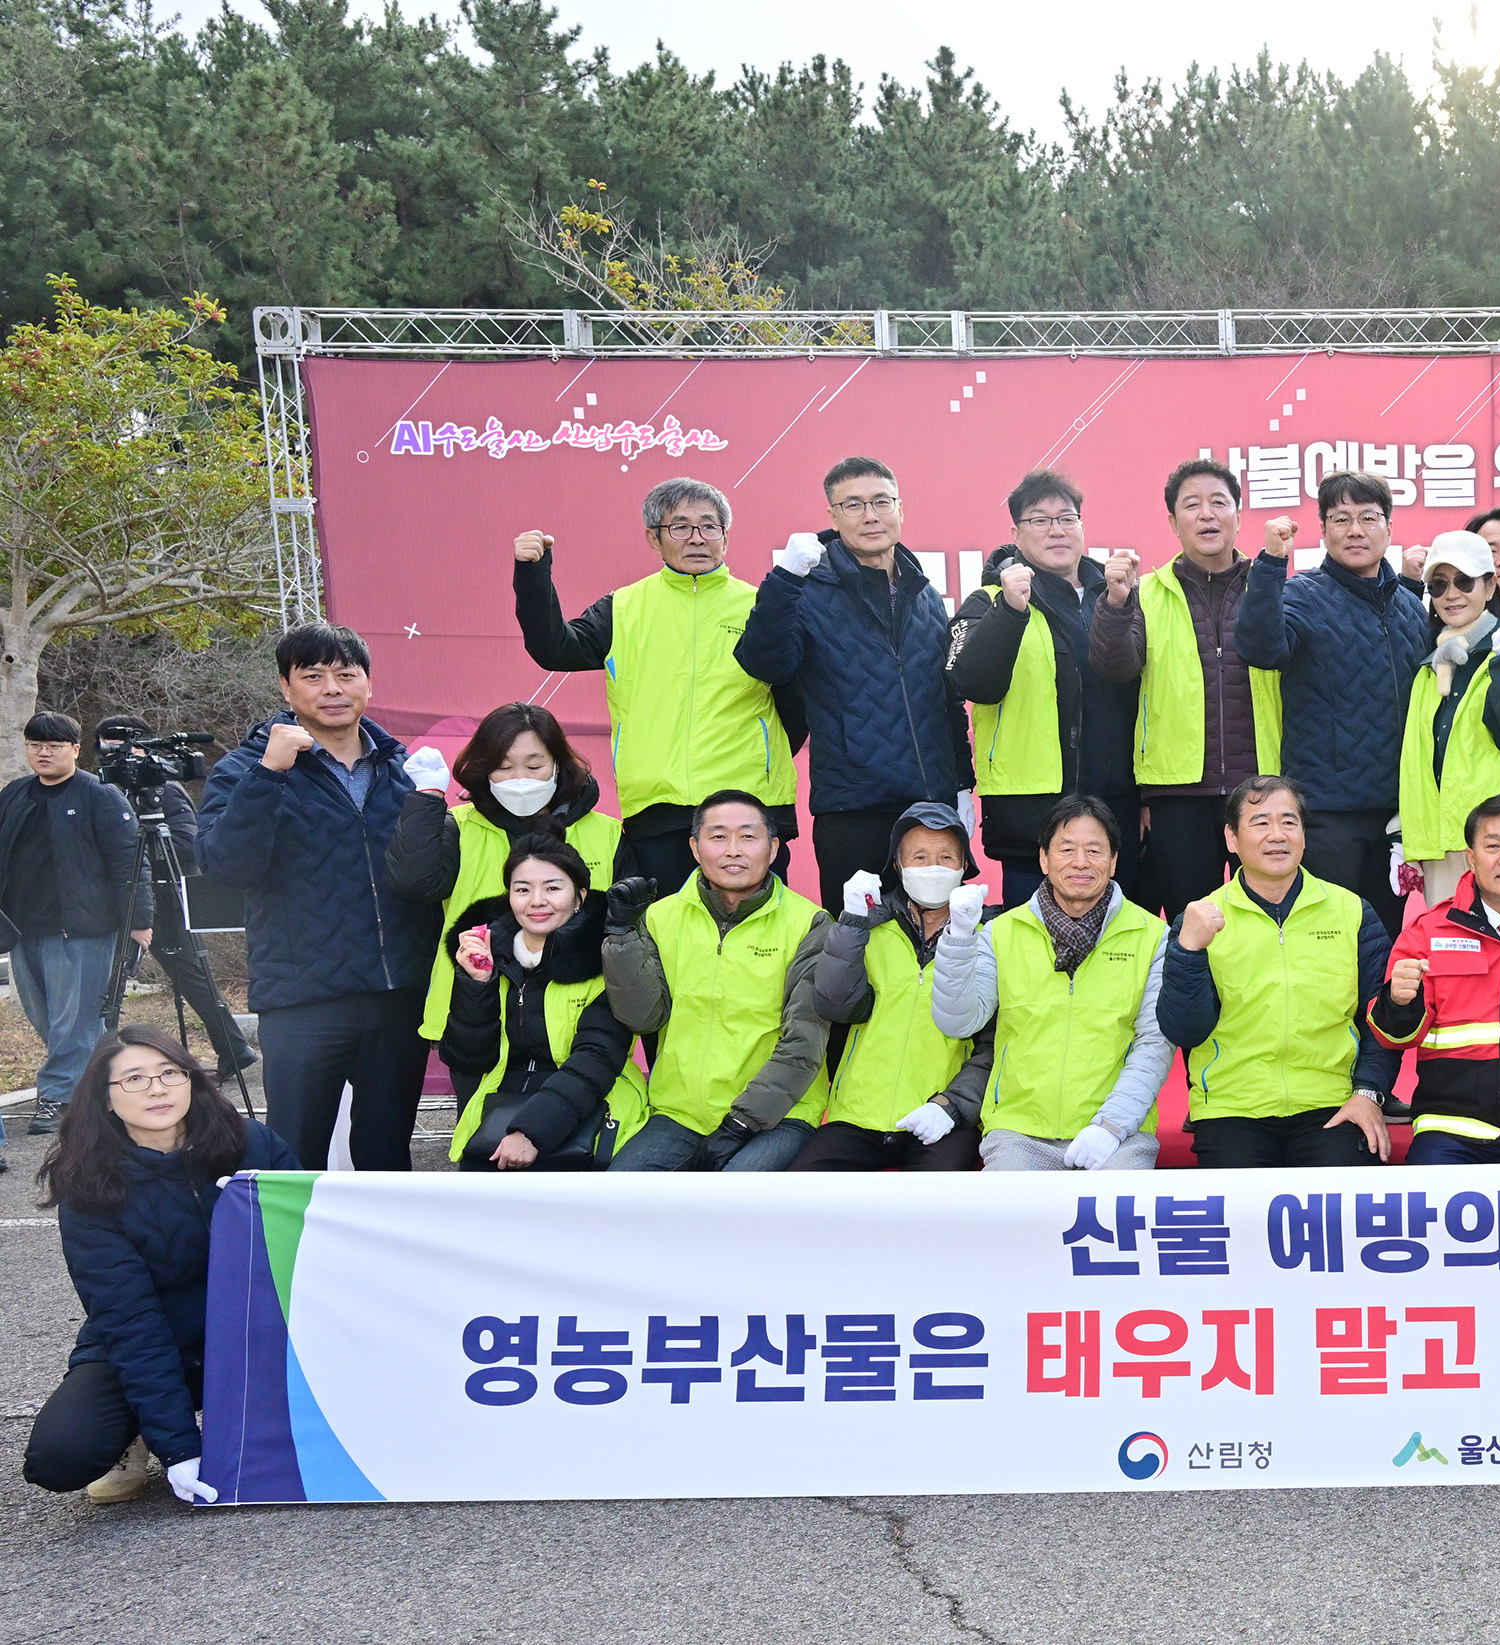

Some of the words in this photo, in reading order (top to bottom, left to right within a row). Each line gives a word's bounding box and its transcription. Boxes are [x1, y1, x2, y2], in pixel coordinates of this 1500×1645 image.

[1199, 440, 1476, 509] 불예방을
[1062, 1195, 1231, 1276] 산불
[462, 1312, 989, 1407] 영농부산물은
[1026, 1307, 1275, 1399] 태우지
[1315, 1306, 1481, 1396] 말고
[1187, 1441, 1272, 1470] 산림청
